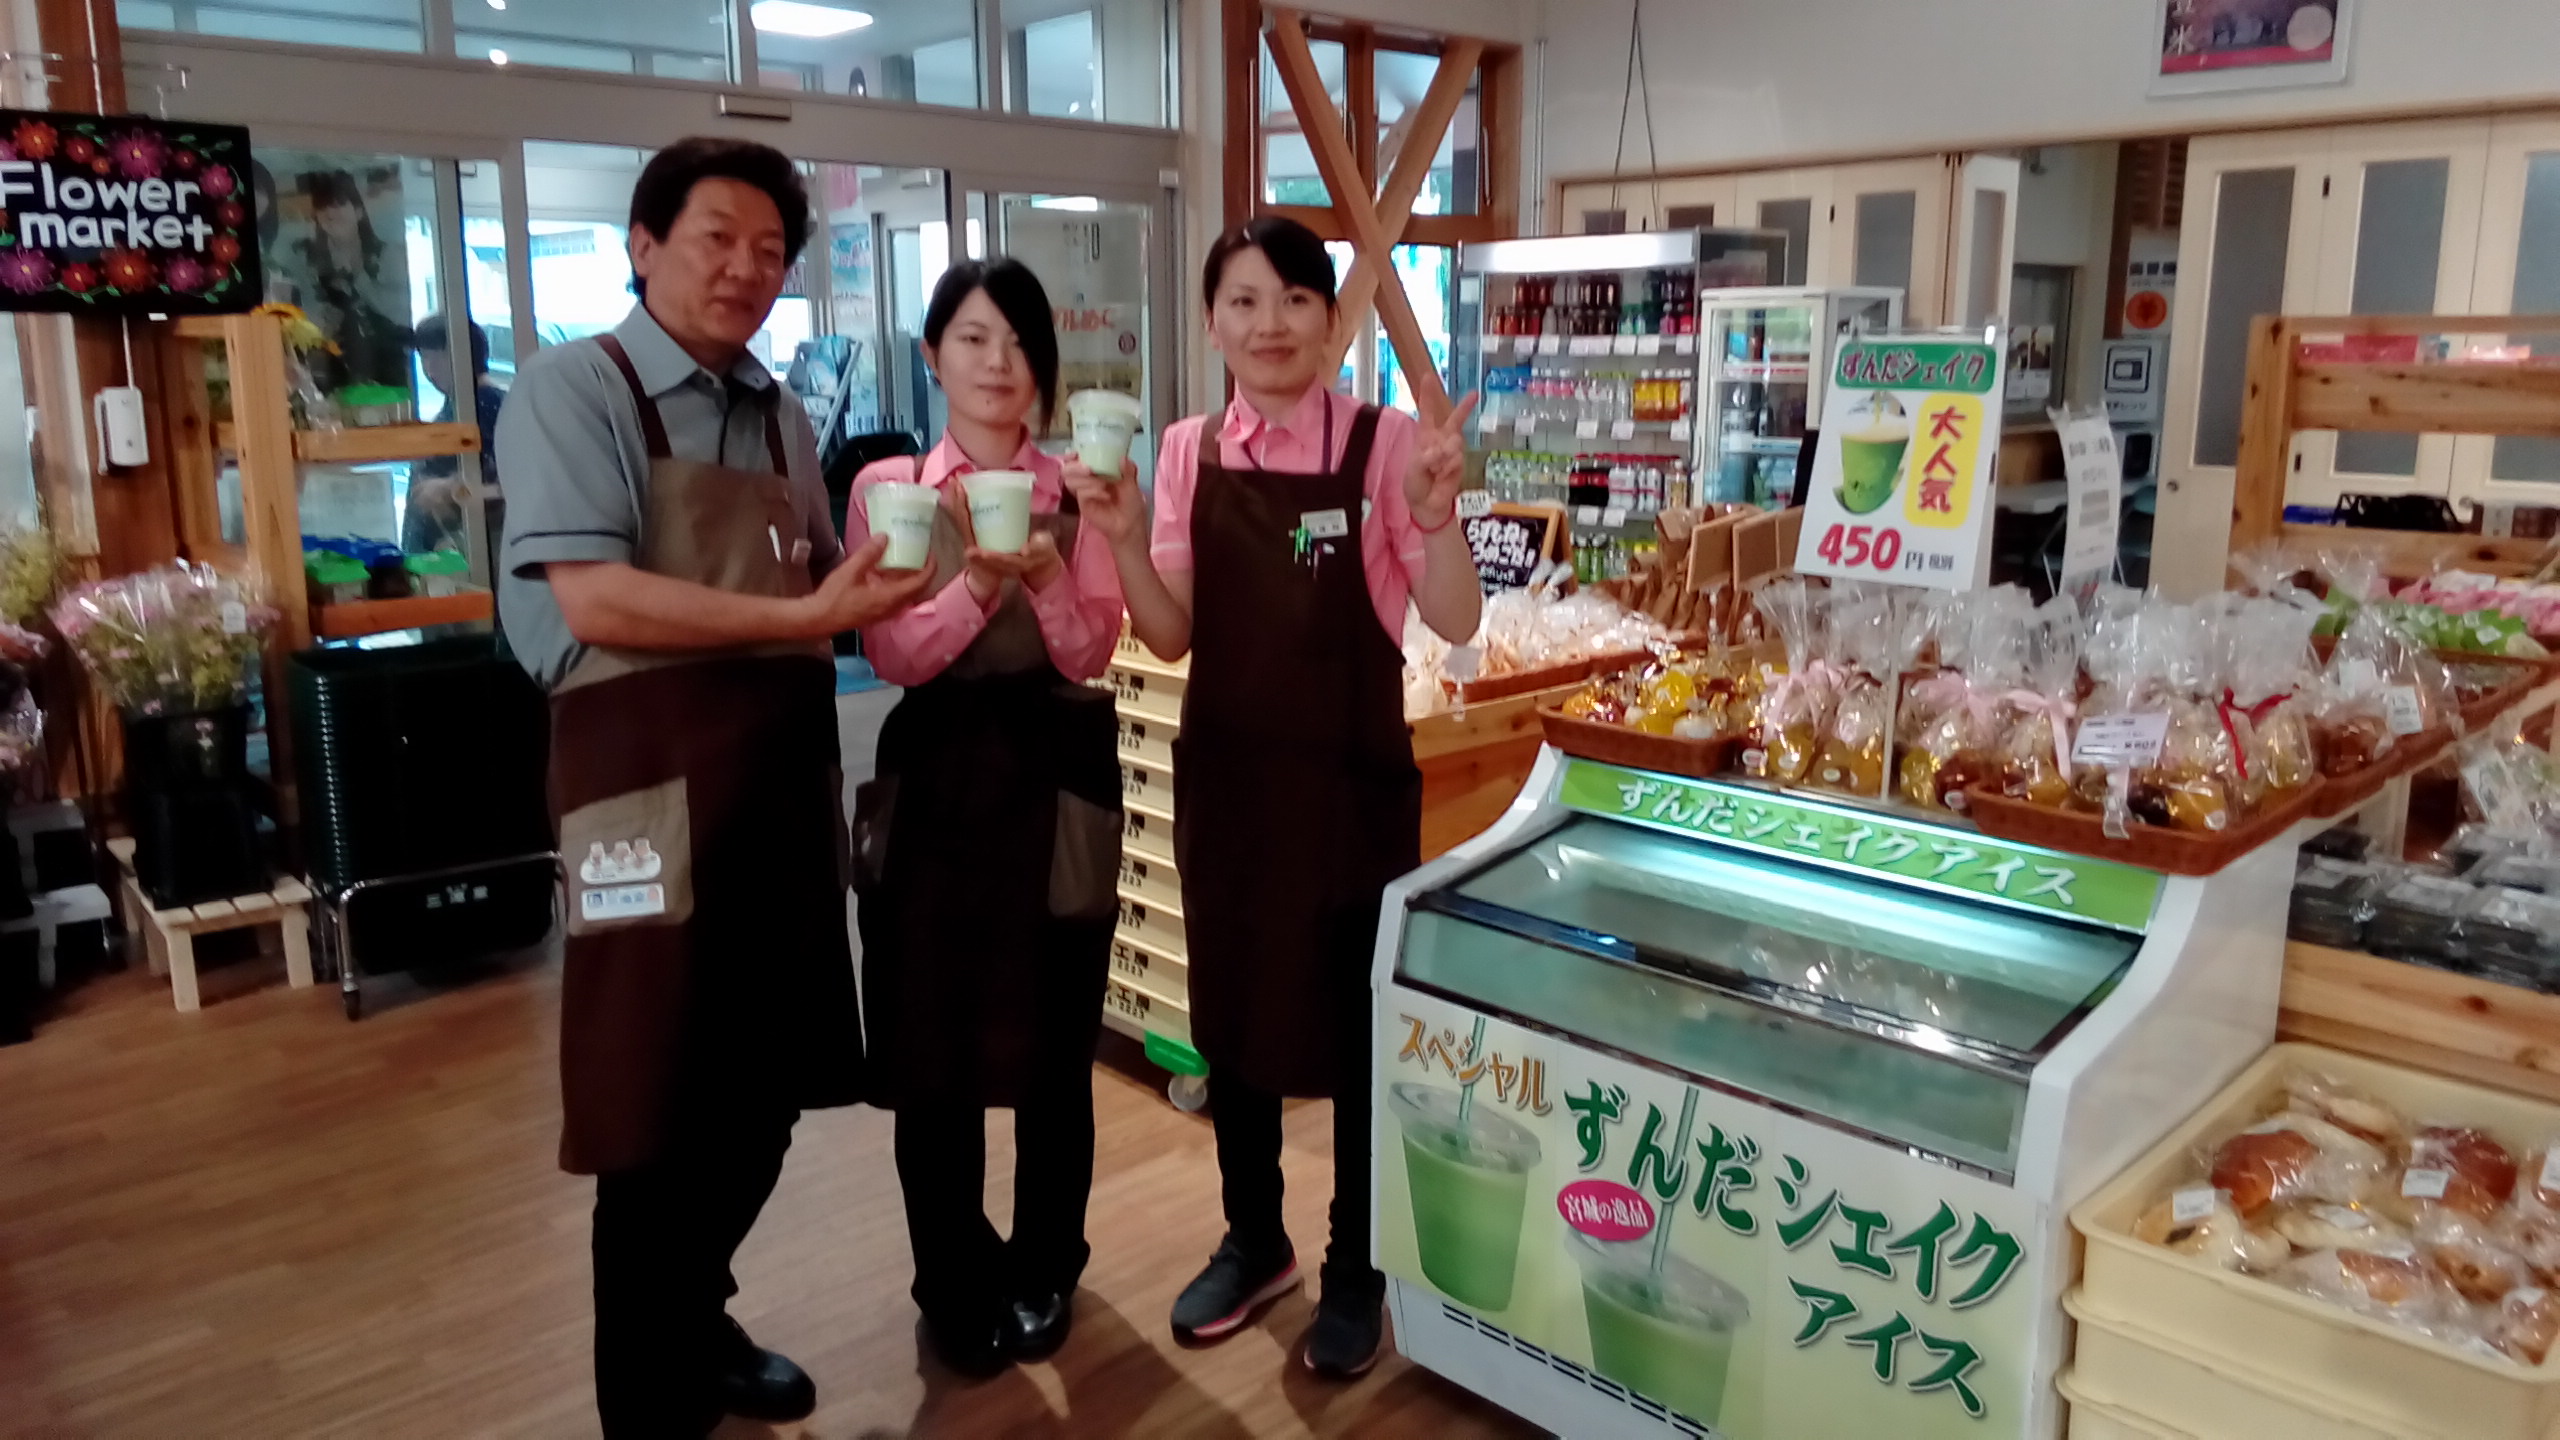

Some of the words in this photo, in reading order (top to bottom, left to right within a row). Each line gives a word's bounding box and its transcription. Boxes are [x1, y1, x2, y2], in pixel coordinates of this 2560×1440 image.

[0, 160, 201, 214] Flower
[19, 208, 214, 252] market
[1841, 351, 1986, 385] ずんだシェイク
[1918, 406, 1967, 513] 大人気
[1617, 777, 2076, 906] ずんだシェイクアイス
[1398, 1012, 1553, 1115] スペシャル
[1563, 1078, 2026, 1310] ずんだシェイク
[1563, 1192, 1650, 1230] 宮城の逸品
[1786, 1273, 1986, 1419] アイス
